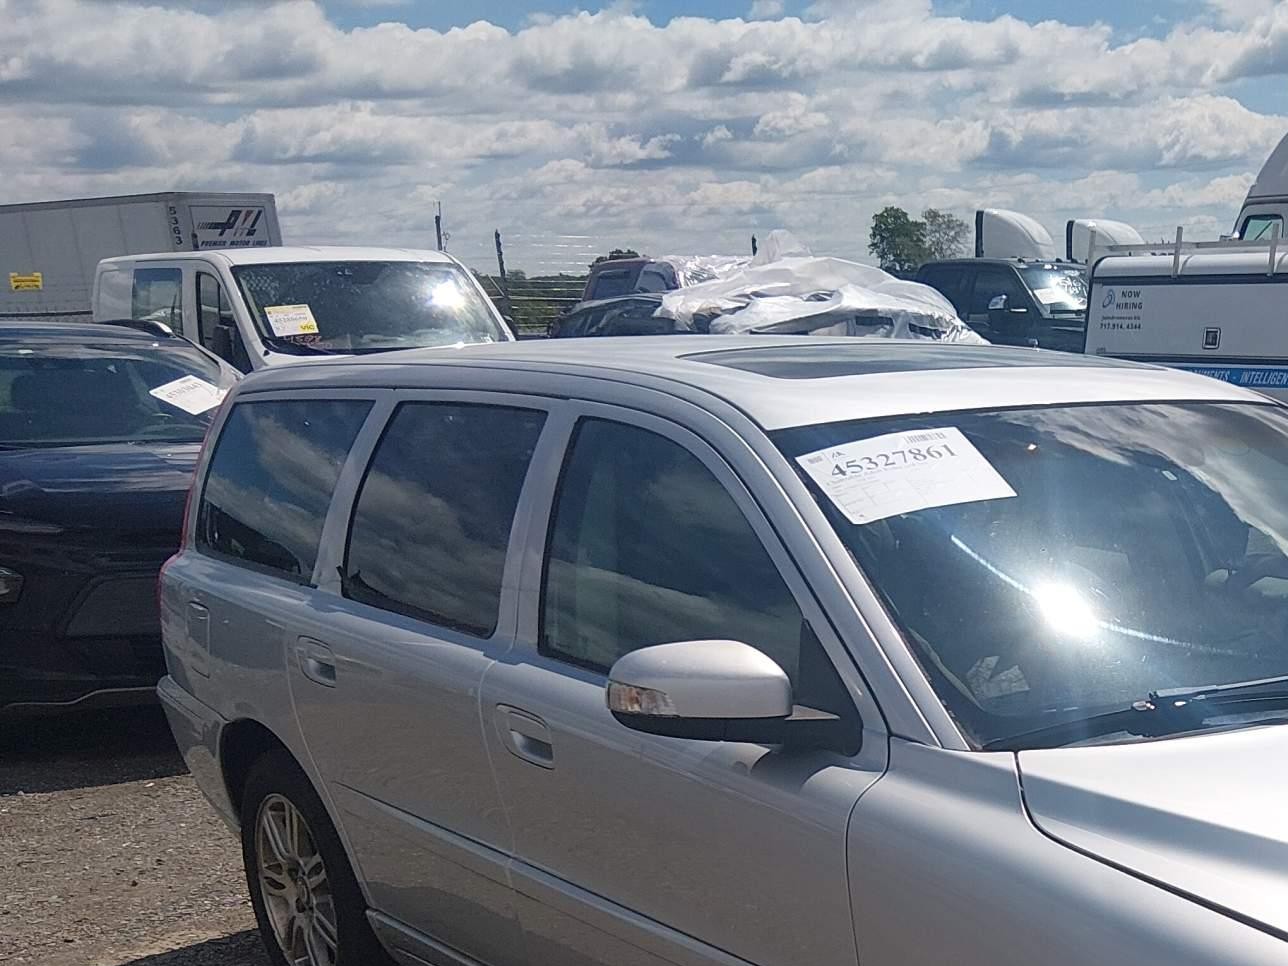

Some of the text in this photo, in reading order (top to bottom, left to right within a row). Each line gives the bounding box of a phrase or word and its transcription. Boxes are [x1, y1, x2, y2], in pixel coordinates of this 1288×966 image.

[169, 206, 183, 245] 5363
[1121, 290, 1141, 298] NOW
[1115, 302, 1143, 310] HIRING
[831, 443, 958, 478] 45327861
